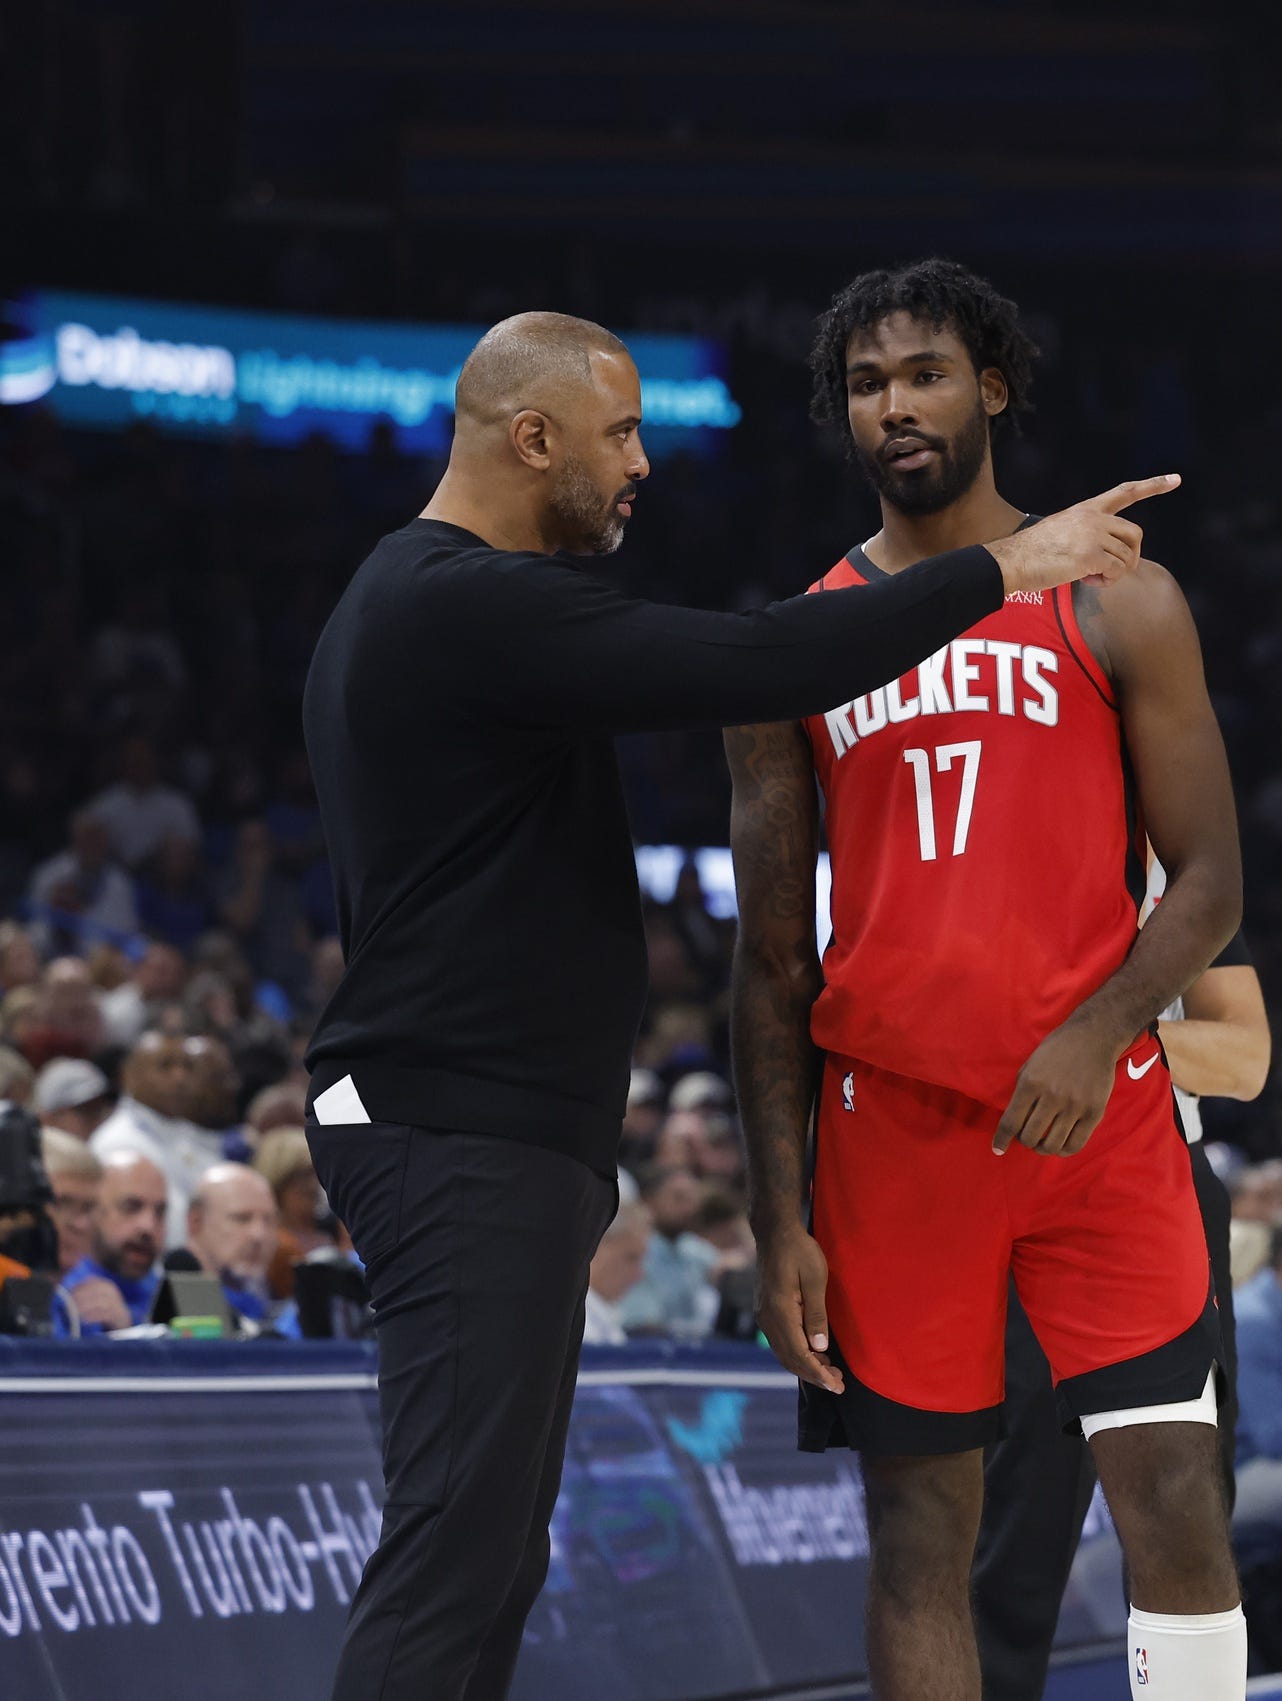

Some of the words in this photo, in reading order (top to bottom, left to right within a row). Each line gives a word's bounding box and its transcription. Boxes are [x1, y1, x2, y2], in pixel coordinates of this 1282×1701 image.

[824, 638, 1059, 760] ROCKETS
[904, 740, 982, 862] 17
[138, 1480, 383, 1618] Turbo-Hy
